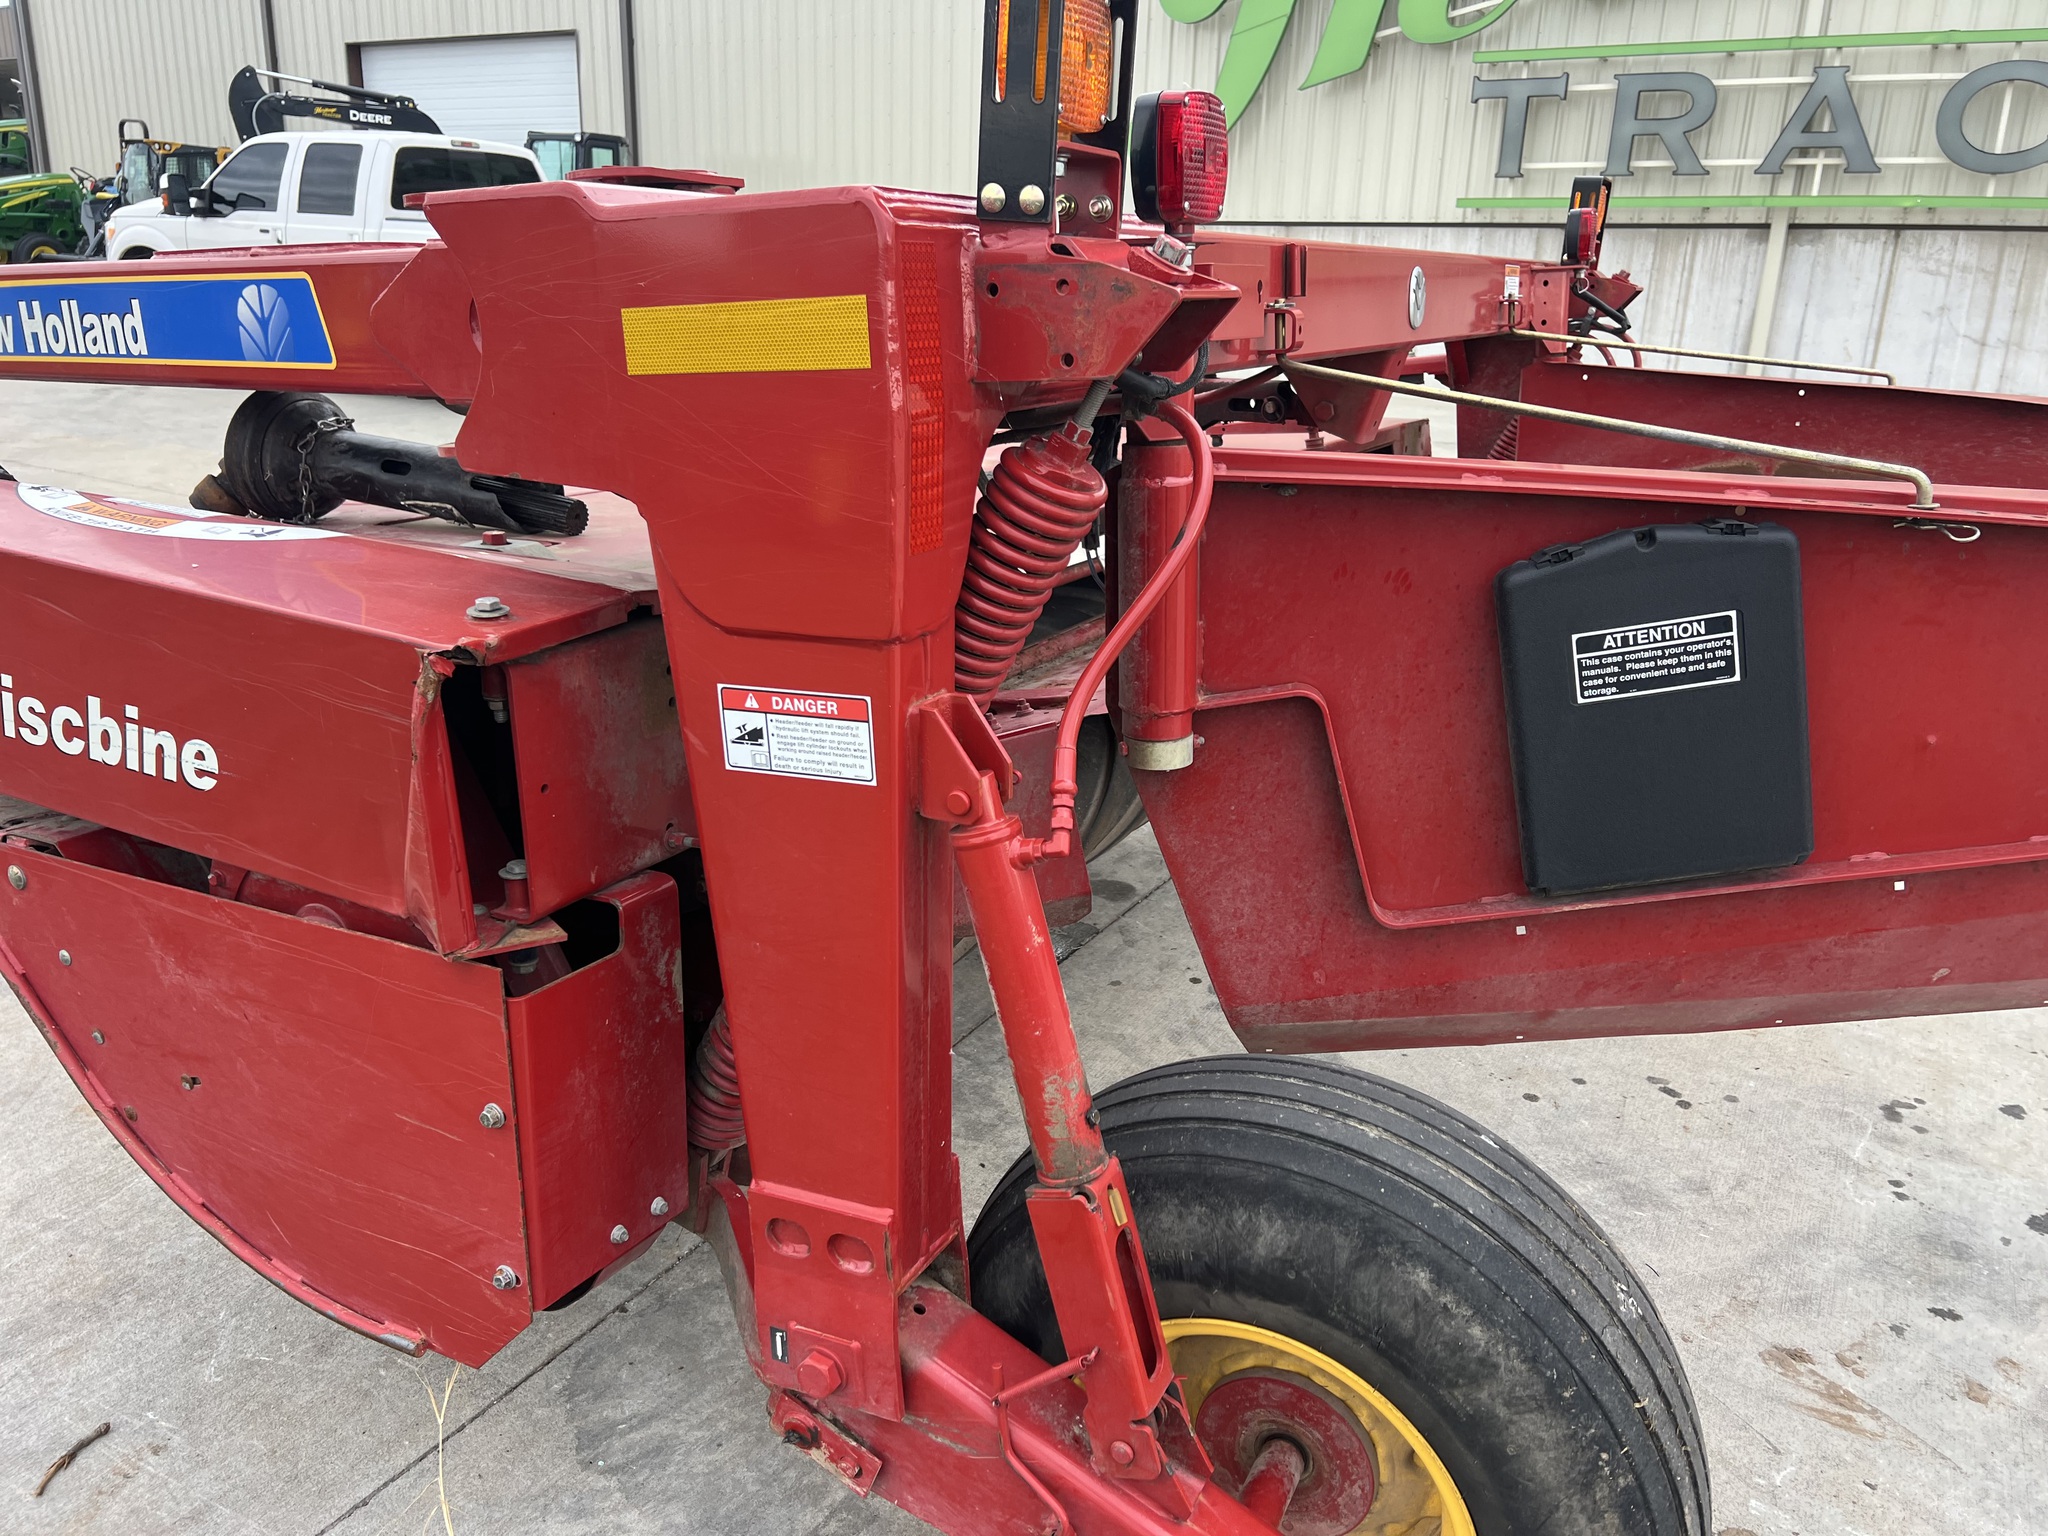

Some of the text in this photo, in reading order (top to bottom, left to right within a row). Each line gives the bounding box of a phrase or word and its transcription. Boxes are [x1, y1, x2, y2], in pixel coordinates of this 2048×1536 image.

[349, 109, 392, 125] DEERE
[18, 298, 148, 356] Holland
[94, 508, 167, 527] WARNING
[1603, 620, 1706, 649] ATTENTION
[1581, 658, 1600, 667] This
[1602, 655, 1623, 664] case
[1625, 649, 1663, 661] contains
[1664, 646, 1685, 657] your
[1582, 649, 1732, 677] manuals. Please keep them in this
[1582, 660, 1726, 687] case for convenient use and safe
[1583, 686, 1619, 697] storage.
[771, 696, 838, 715] DANGER
[0, 673, 219, 791] iscbine
[775, 718, 813, 727] Header/feeder
[775, 725, 800, 733] hydraulic
[790, 734, 827, 743] header/feeder
[773, 754, 794, 762] Failure
[803, 758, 825, 767] comply
